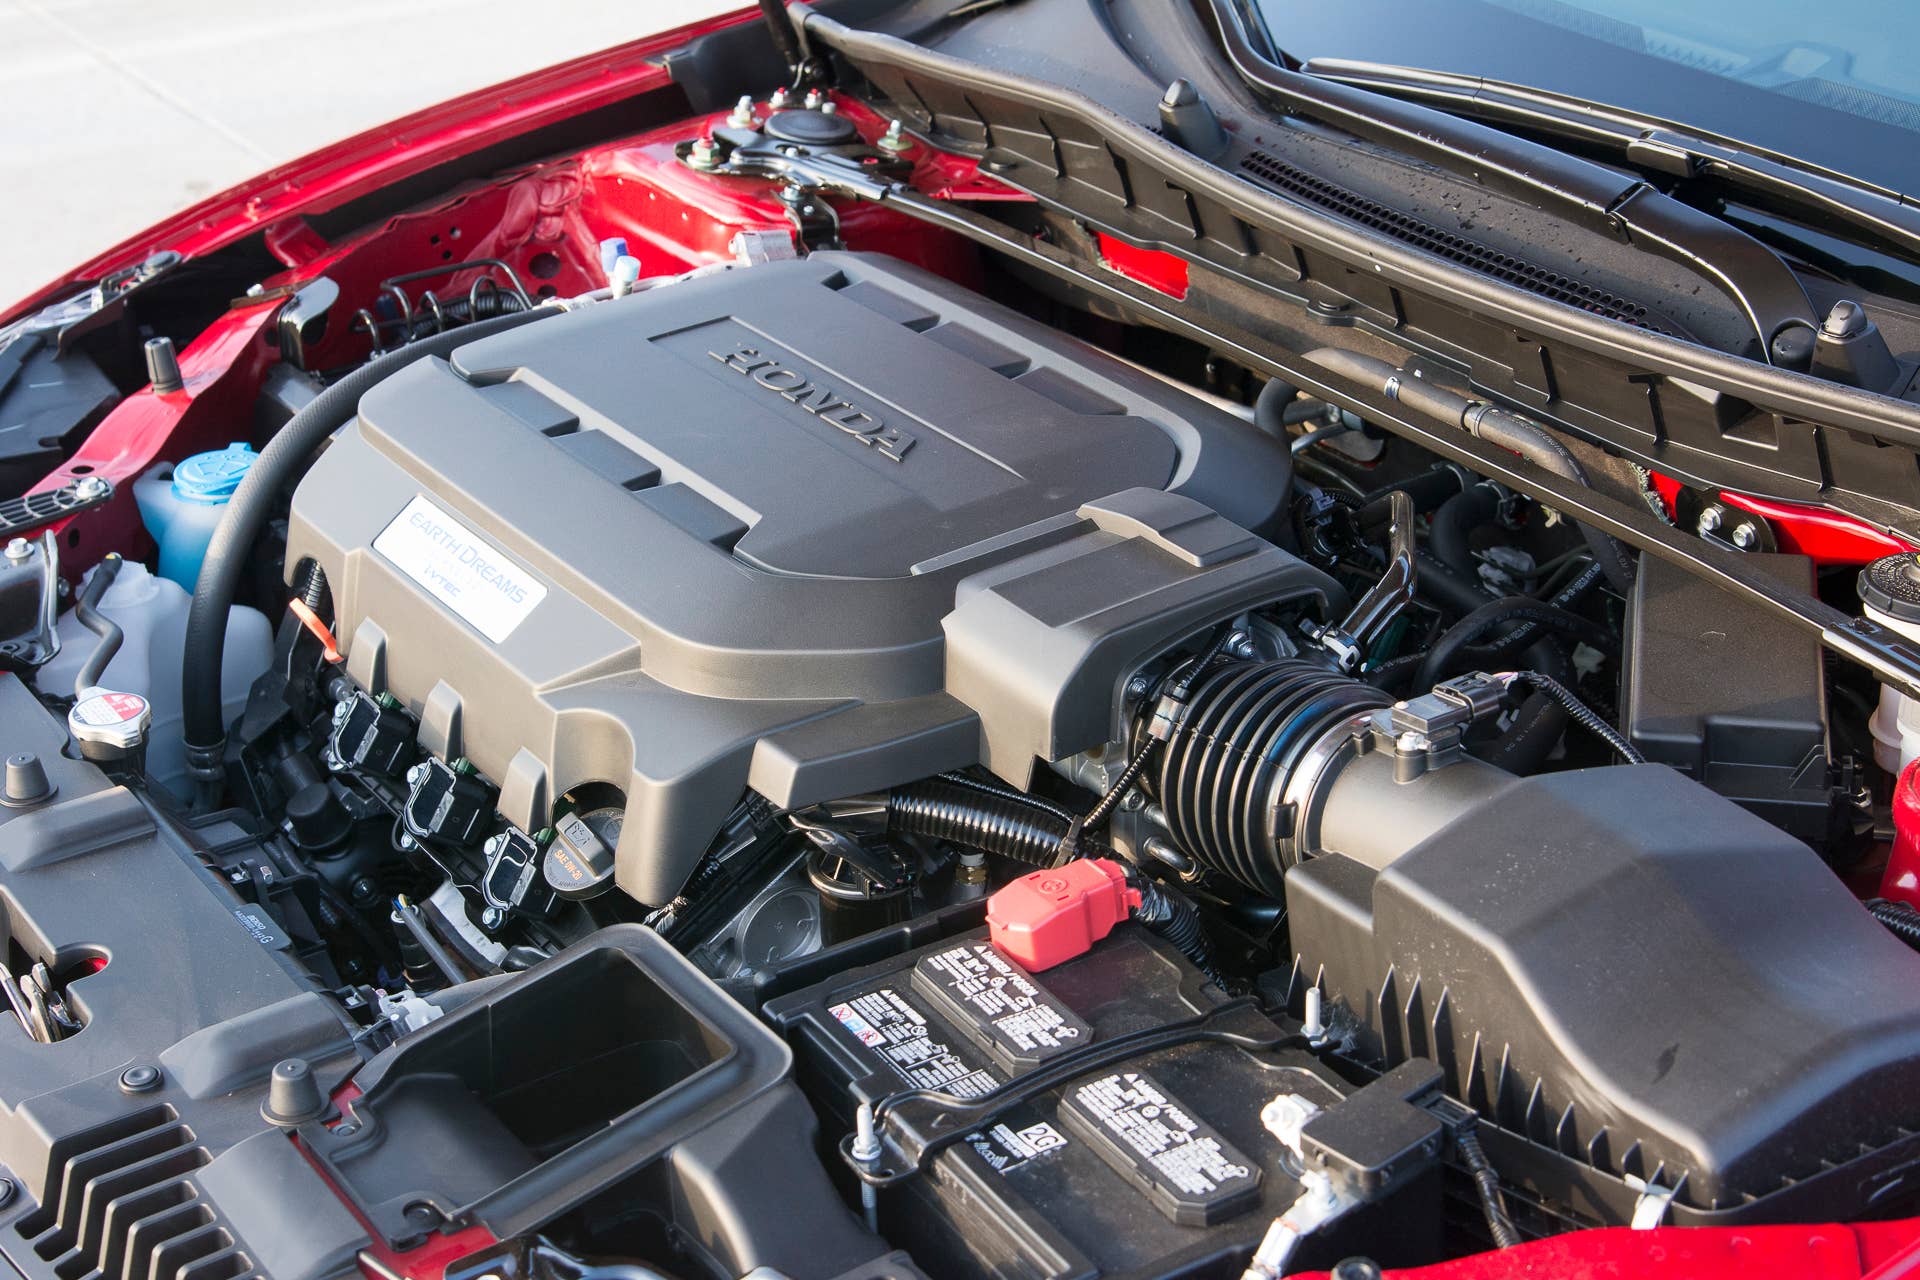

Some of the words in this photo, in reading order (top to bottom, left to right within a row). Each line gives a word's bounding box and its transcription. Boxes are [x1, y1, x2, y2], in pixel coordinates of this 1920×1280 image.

[708, 342, 917, 463] HONDA
[409, 512, 463, 555] EARTH
[458, 545, 528, 604] DREAMS
[554, 849, 570, 865] SAE
[1023, 1127, 1059, 1148] 2G
